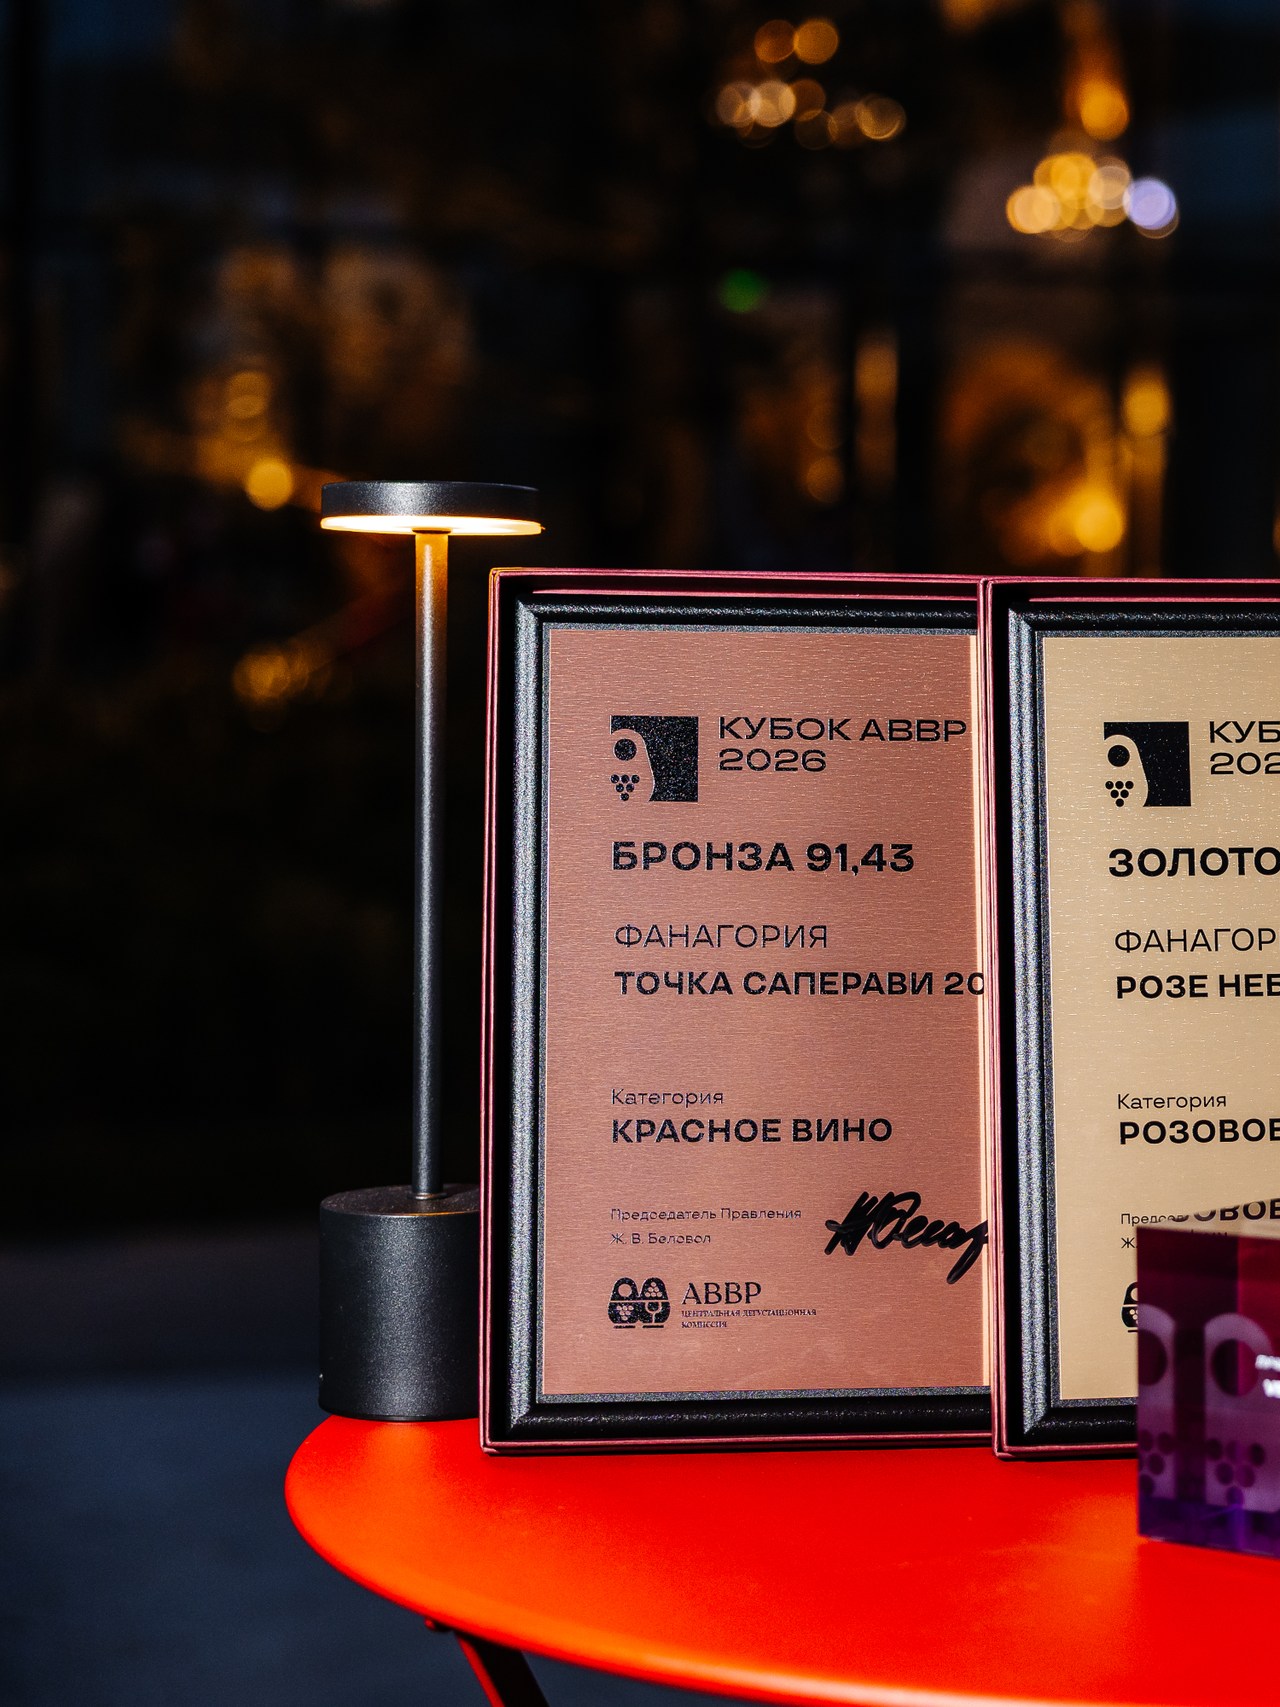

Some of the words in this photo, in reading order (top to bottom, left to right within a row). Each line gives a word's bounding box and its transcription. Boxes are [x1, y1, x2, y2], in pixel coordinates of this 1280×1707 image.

[718, 716, 852, 741] КУБОК
[859, 719, 968, 742] АВВР
[718, 748, 827, 772] 2026
[611, 840, 796, 873] БРОНЗА
[805, 842, 915, 876] 91,43
[614, 923, 828, 949] ФАНАГОРИЯ
[613, 971, 734, 996] ТОЧКА
[742, 971, 934, 996] САПЕРАВИ
[1116, 974, 1208, 999] РОЗЕ
[611, 1088, 725, 1109] Категория
[1117, 1092, 1227, 1113] Категория
[611, 1118, 782, 1144] КРАСНОЕ
[792, 1117, 894, 1143] ВИНО
[610, 1208, 717, 1223] Председатель
[720, 1207, 802, 1222] Правления
[631, 1232, 645, 1245] В.
[648, 1232, 711, 1244] Беловол
[681, 1281, 762, 1305] АВВР
[681, 1310, 741, 1318] ЦЕНТРАЛЬНАЯ
[681, 1320, 728, 1329] КОМИССИЯ
